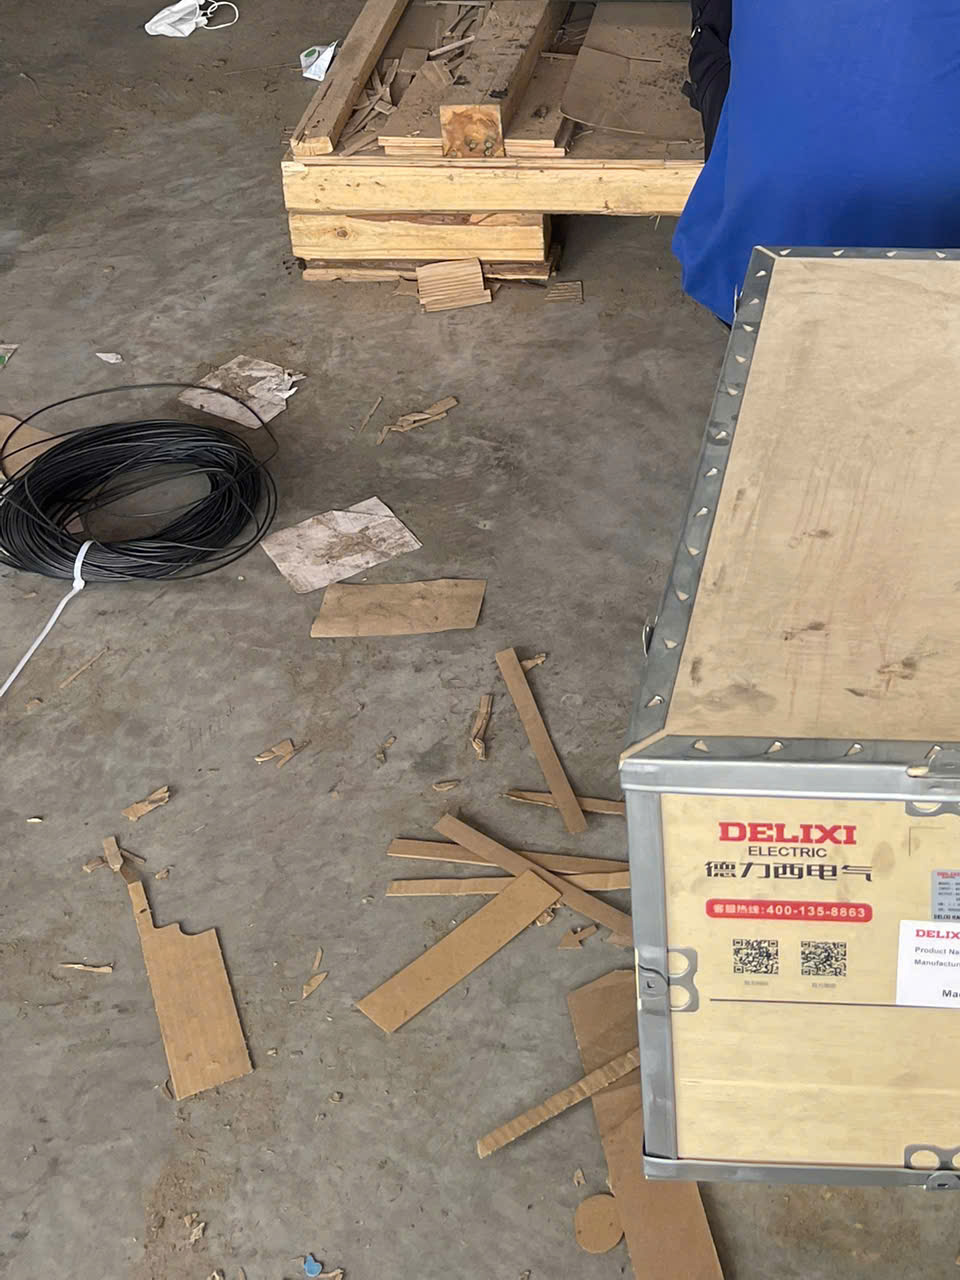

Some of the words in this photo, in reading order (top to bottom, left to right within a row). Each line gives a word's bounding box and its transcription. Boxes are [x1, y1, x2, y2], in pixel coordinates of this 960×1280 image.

[718, 821, 857, 845] DELIXI
[748, 846, 828, 858] ELECTRIC
[704, 860, 873, 882] 德力西电气
[914, 946, 947, 955] Product
